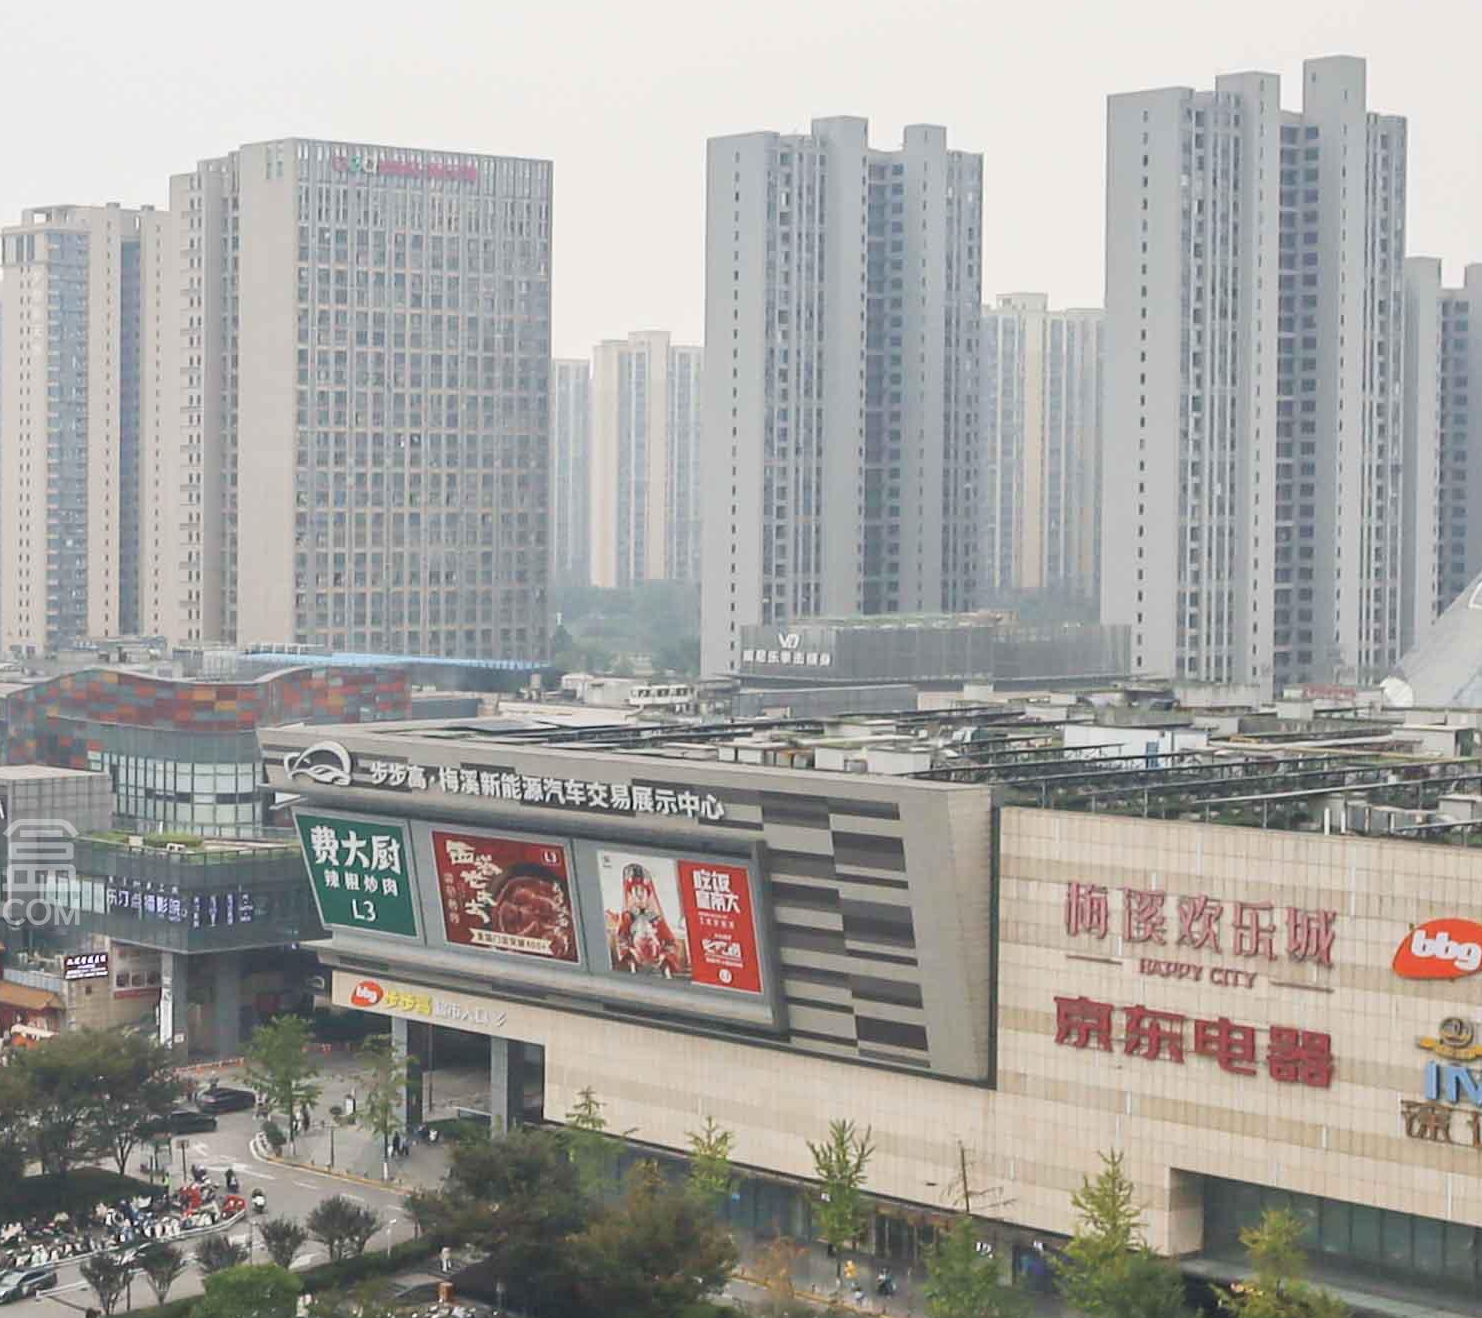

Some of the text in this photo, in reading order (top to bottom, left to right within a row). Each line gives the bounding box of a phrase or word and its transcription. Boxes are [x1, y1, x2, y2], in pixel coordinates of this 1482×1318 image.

[370, 759, 726, 821] 步步高·梅溪新能源汽车交易展示中心
[310, 824, 402, 876] 费大厨
[351, 897, 377, 923] L3
[1064, 880, 1337, 969] 梅溪欢乐城
[1139, 957, 1259, 989] HAPPY CITY
[1053, 995, 1335, 1090] 京东电器
